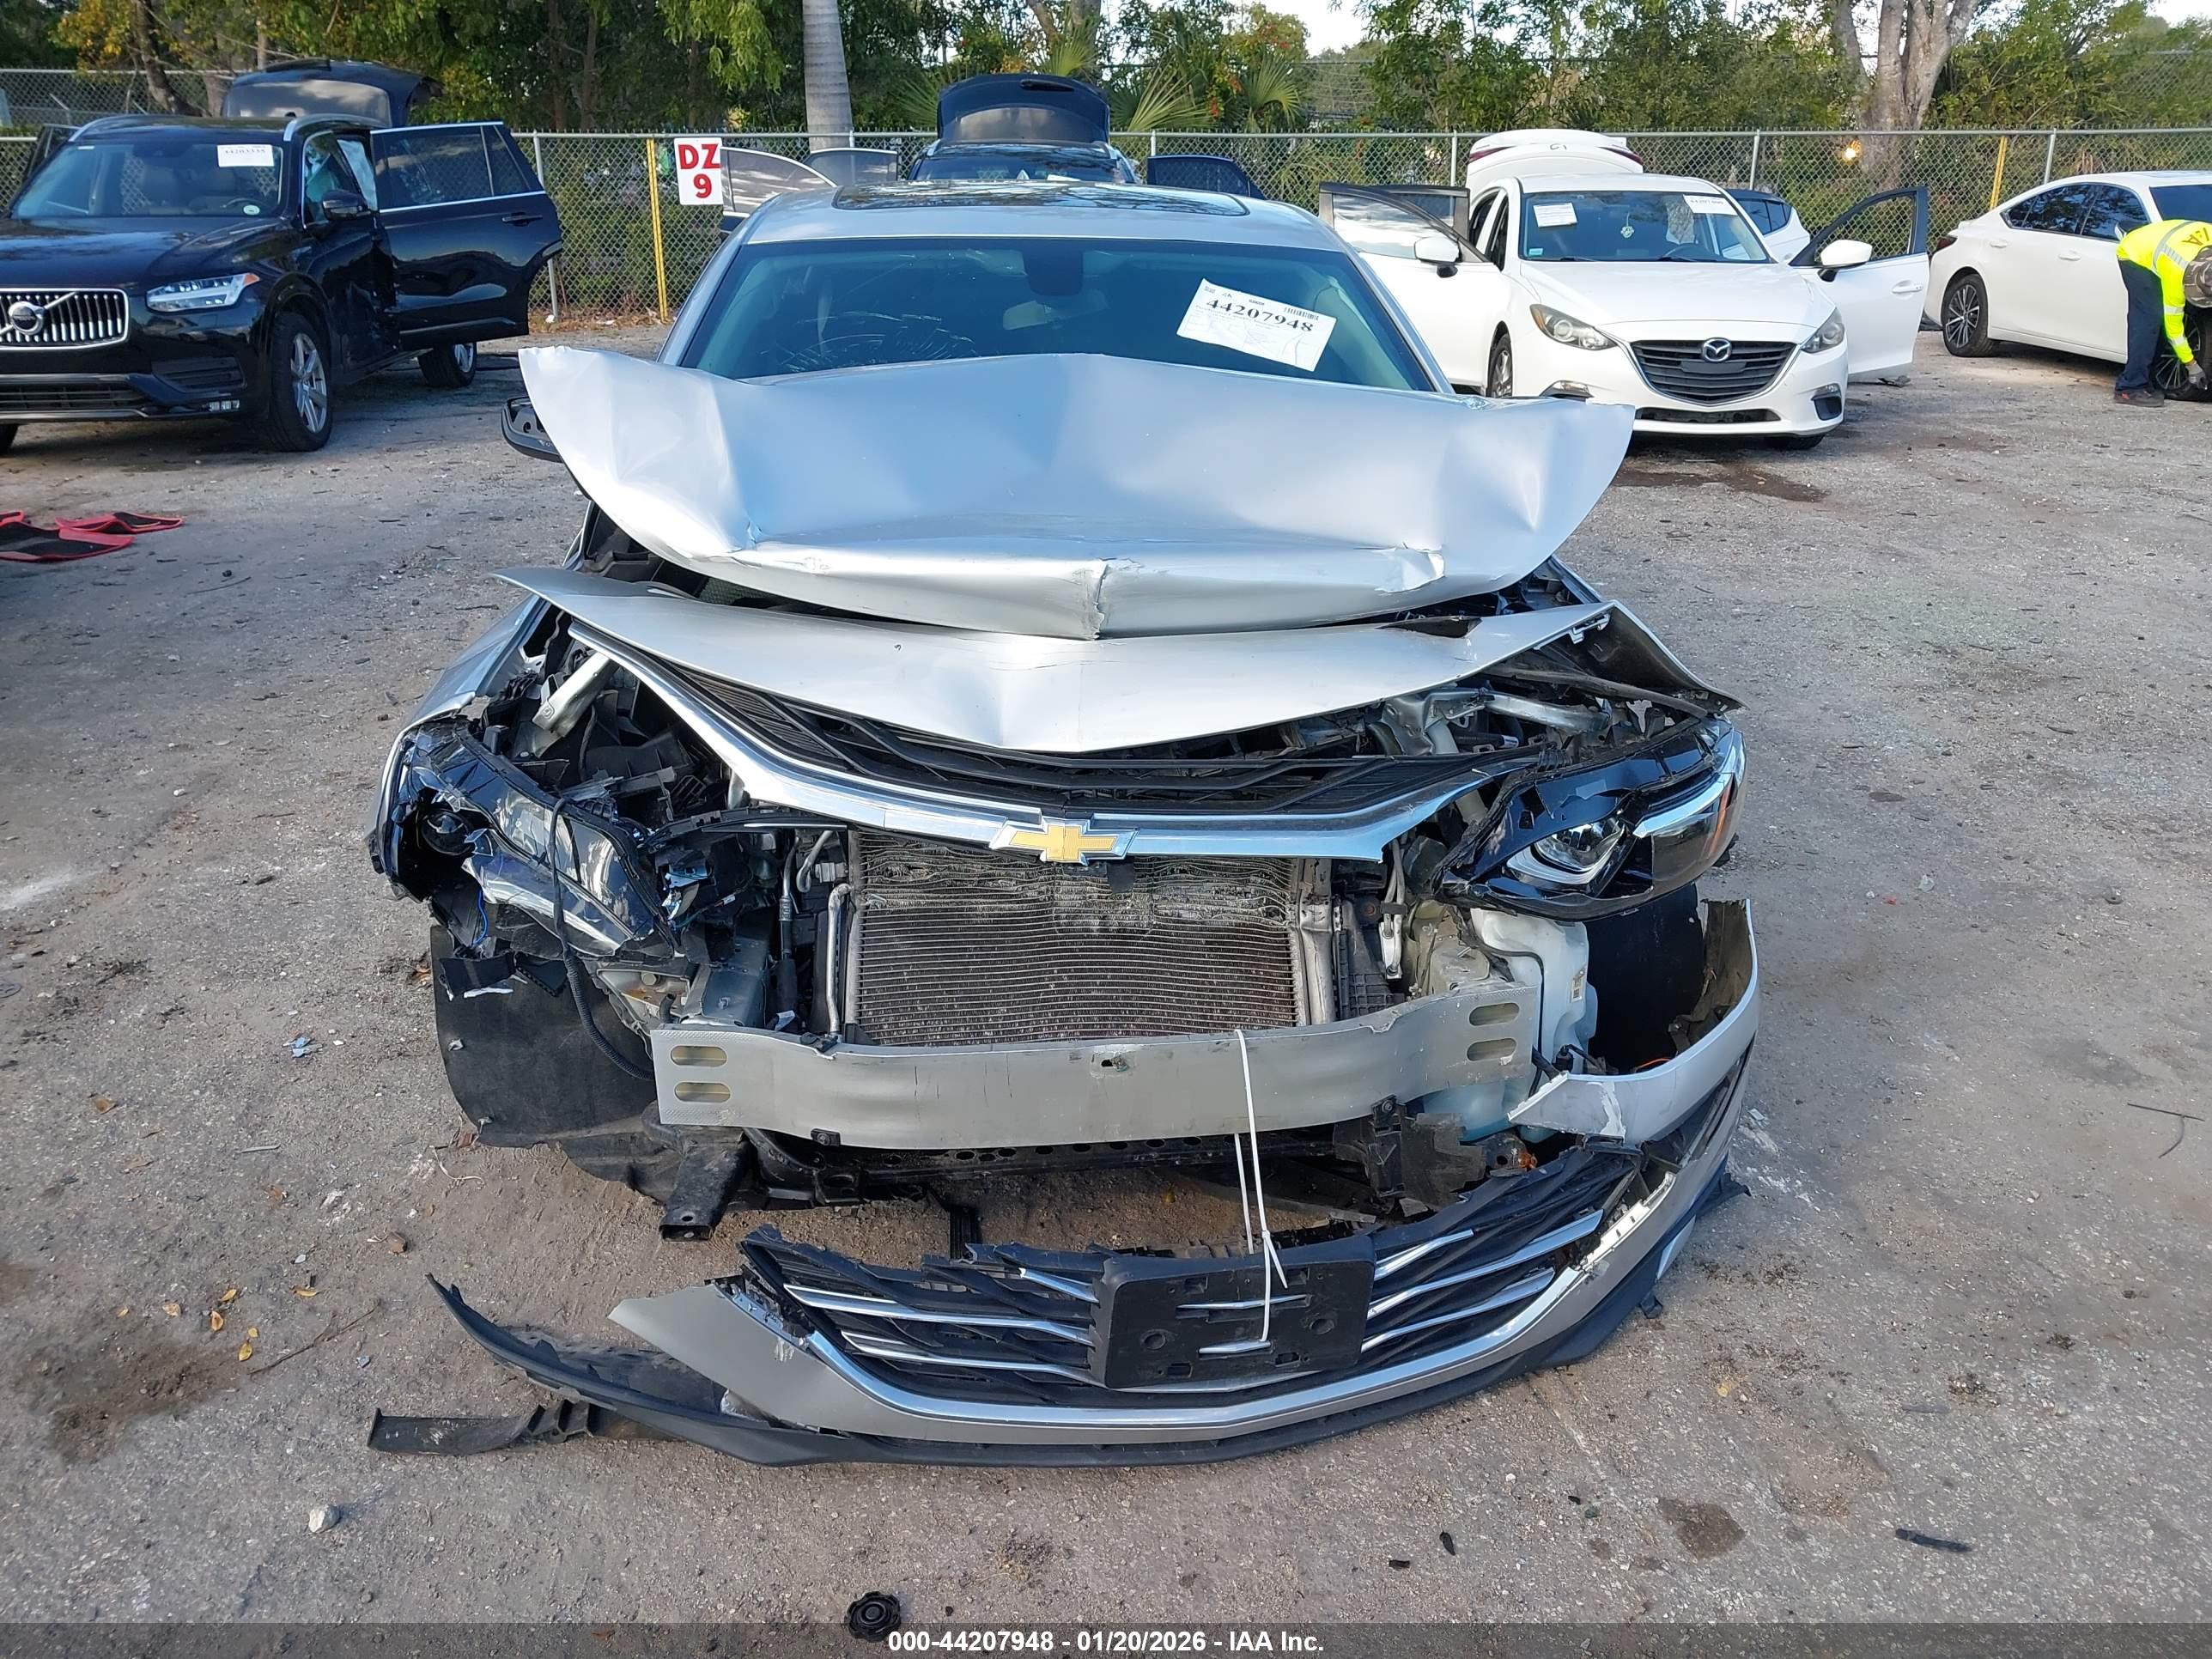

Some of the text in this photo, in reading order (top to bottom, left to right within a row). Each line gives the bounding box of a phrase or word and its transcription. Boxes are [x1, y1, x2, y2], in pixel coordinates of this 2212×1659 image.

[678, 143, 722, 170] DZ
[693, 173, 712, 198] 9
[1206, 299, 1314, 332] 44207948
